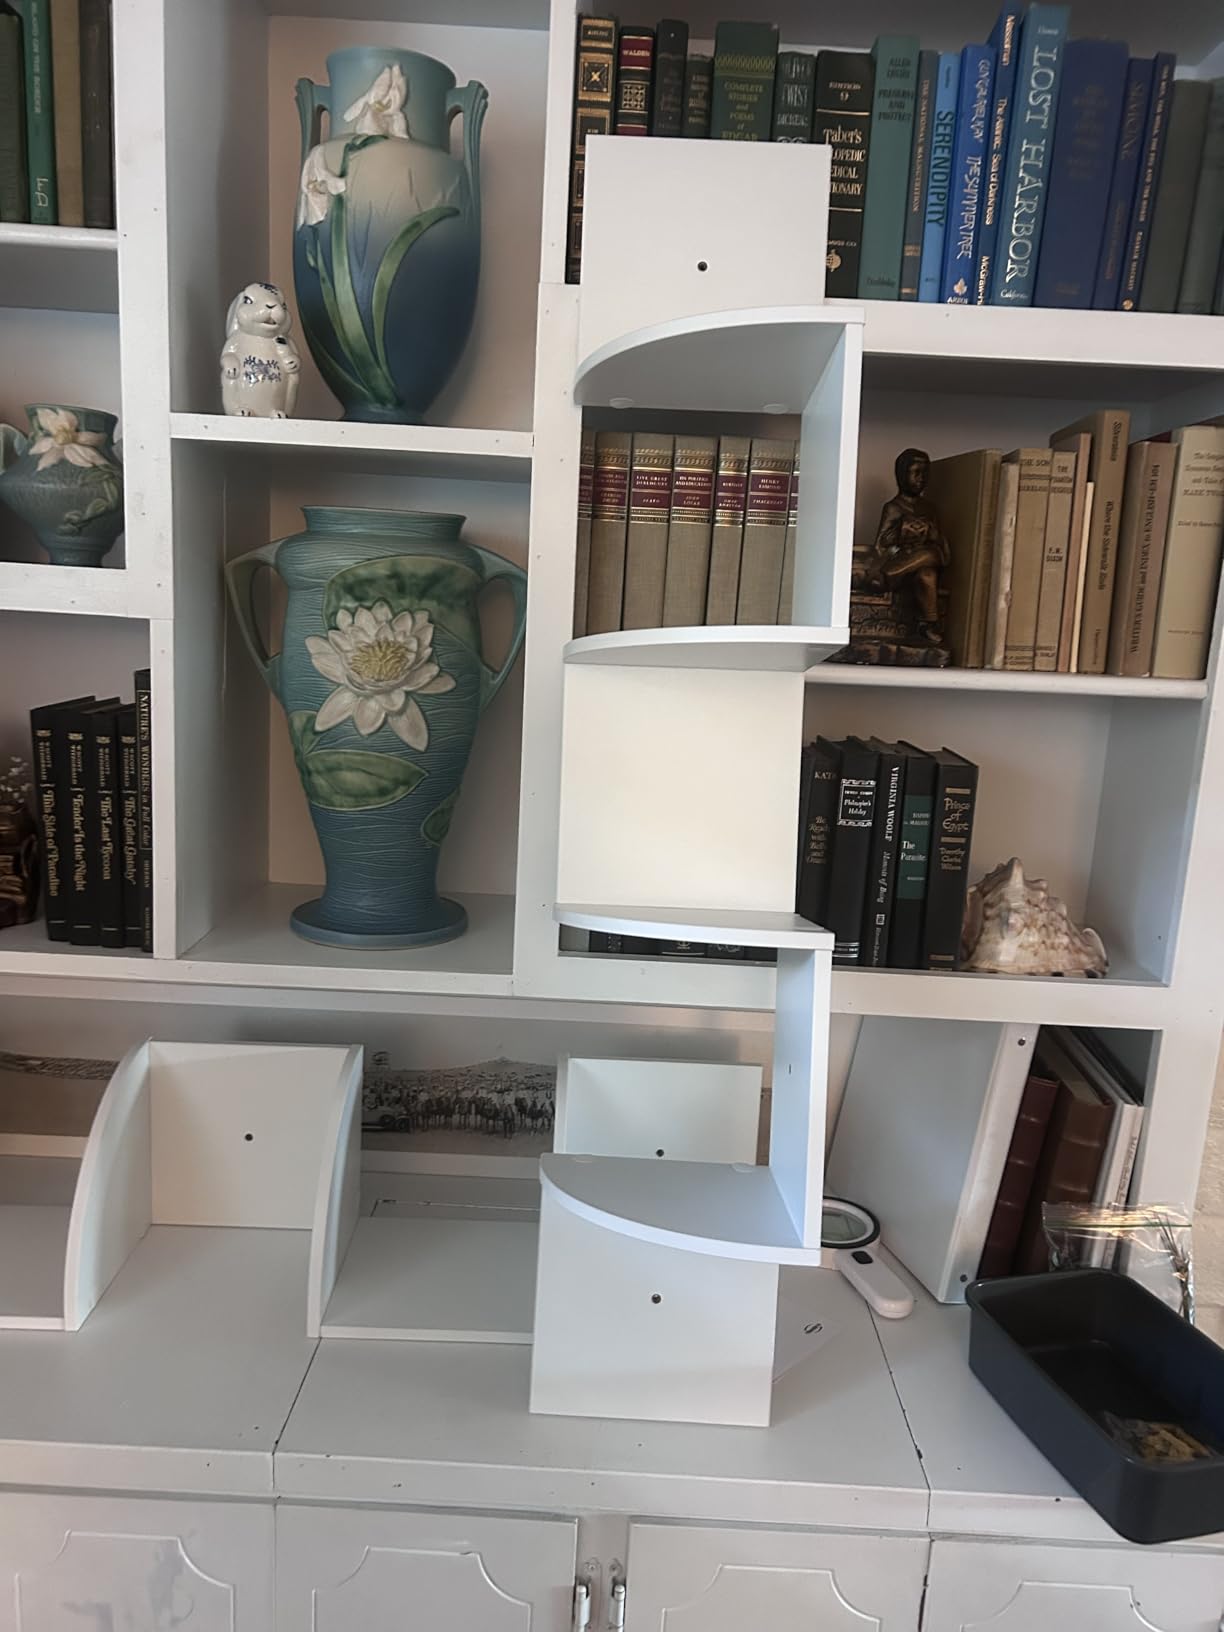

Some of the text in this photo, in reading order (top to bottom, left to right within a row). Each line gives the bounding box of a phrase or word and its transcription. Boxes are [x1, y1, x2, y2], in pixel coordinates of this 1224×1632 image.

[622, 48, 651, 57] WALDEN
[723, 81, 764, 93] COMPLETE
[828, 81, 862, 90] EDITION
[1025, 45, 1058, 129] LOST
[839, 91, 850, 102] 9
[997, 96, 1008, 115] The
[823, 124, 863, 145] Taber's
[831, 148, 866, 162] LOPEDIC
[990, 153, 1001, 173] Sea
[830, 165, 859, 179] EDICAL
[927, 111, 954, 226] SERENDIPITY
[989, 174, 999, 183] of
[956, 156, 982, 260] THE SUMMER TREE
[985, 184, 998, 226] Darkness
[1005, 138, 1046, 283] HARBOR
[1183, 488, 1203, 497] MARK
[1105, 501, 1114, 523] Where
[1103, 524, 1112, 536] the
[139, 694, 150, 846] NATURE'S WONDERS in Full Color
[848, 807, 867, 817] Holiday
[884, 766, 900, 842] VIRGINIA WOOLF
[943, 797, 971, 811] Prince
[950, 810, 962, 821] of
[942, 819, 970, 833] Egypt
[42, 790, 58, 896] This Side of Paradise
[73, 794, 88, 891] Tender Is the Night
[101, 796, 114, 880] The Last Tycoon
[123, 796, 137, 885] The Great Gatsby
[902, 840, 916, 850] The
[939, 847, 966, 857] Dorothy
[876, 886, 886, 903] Being
